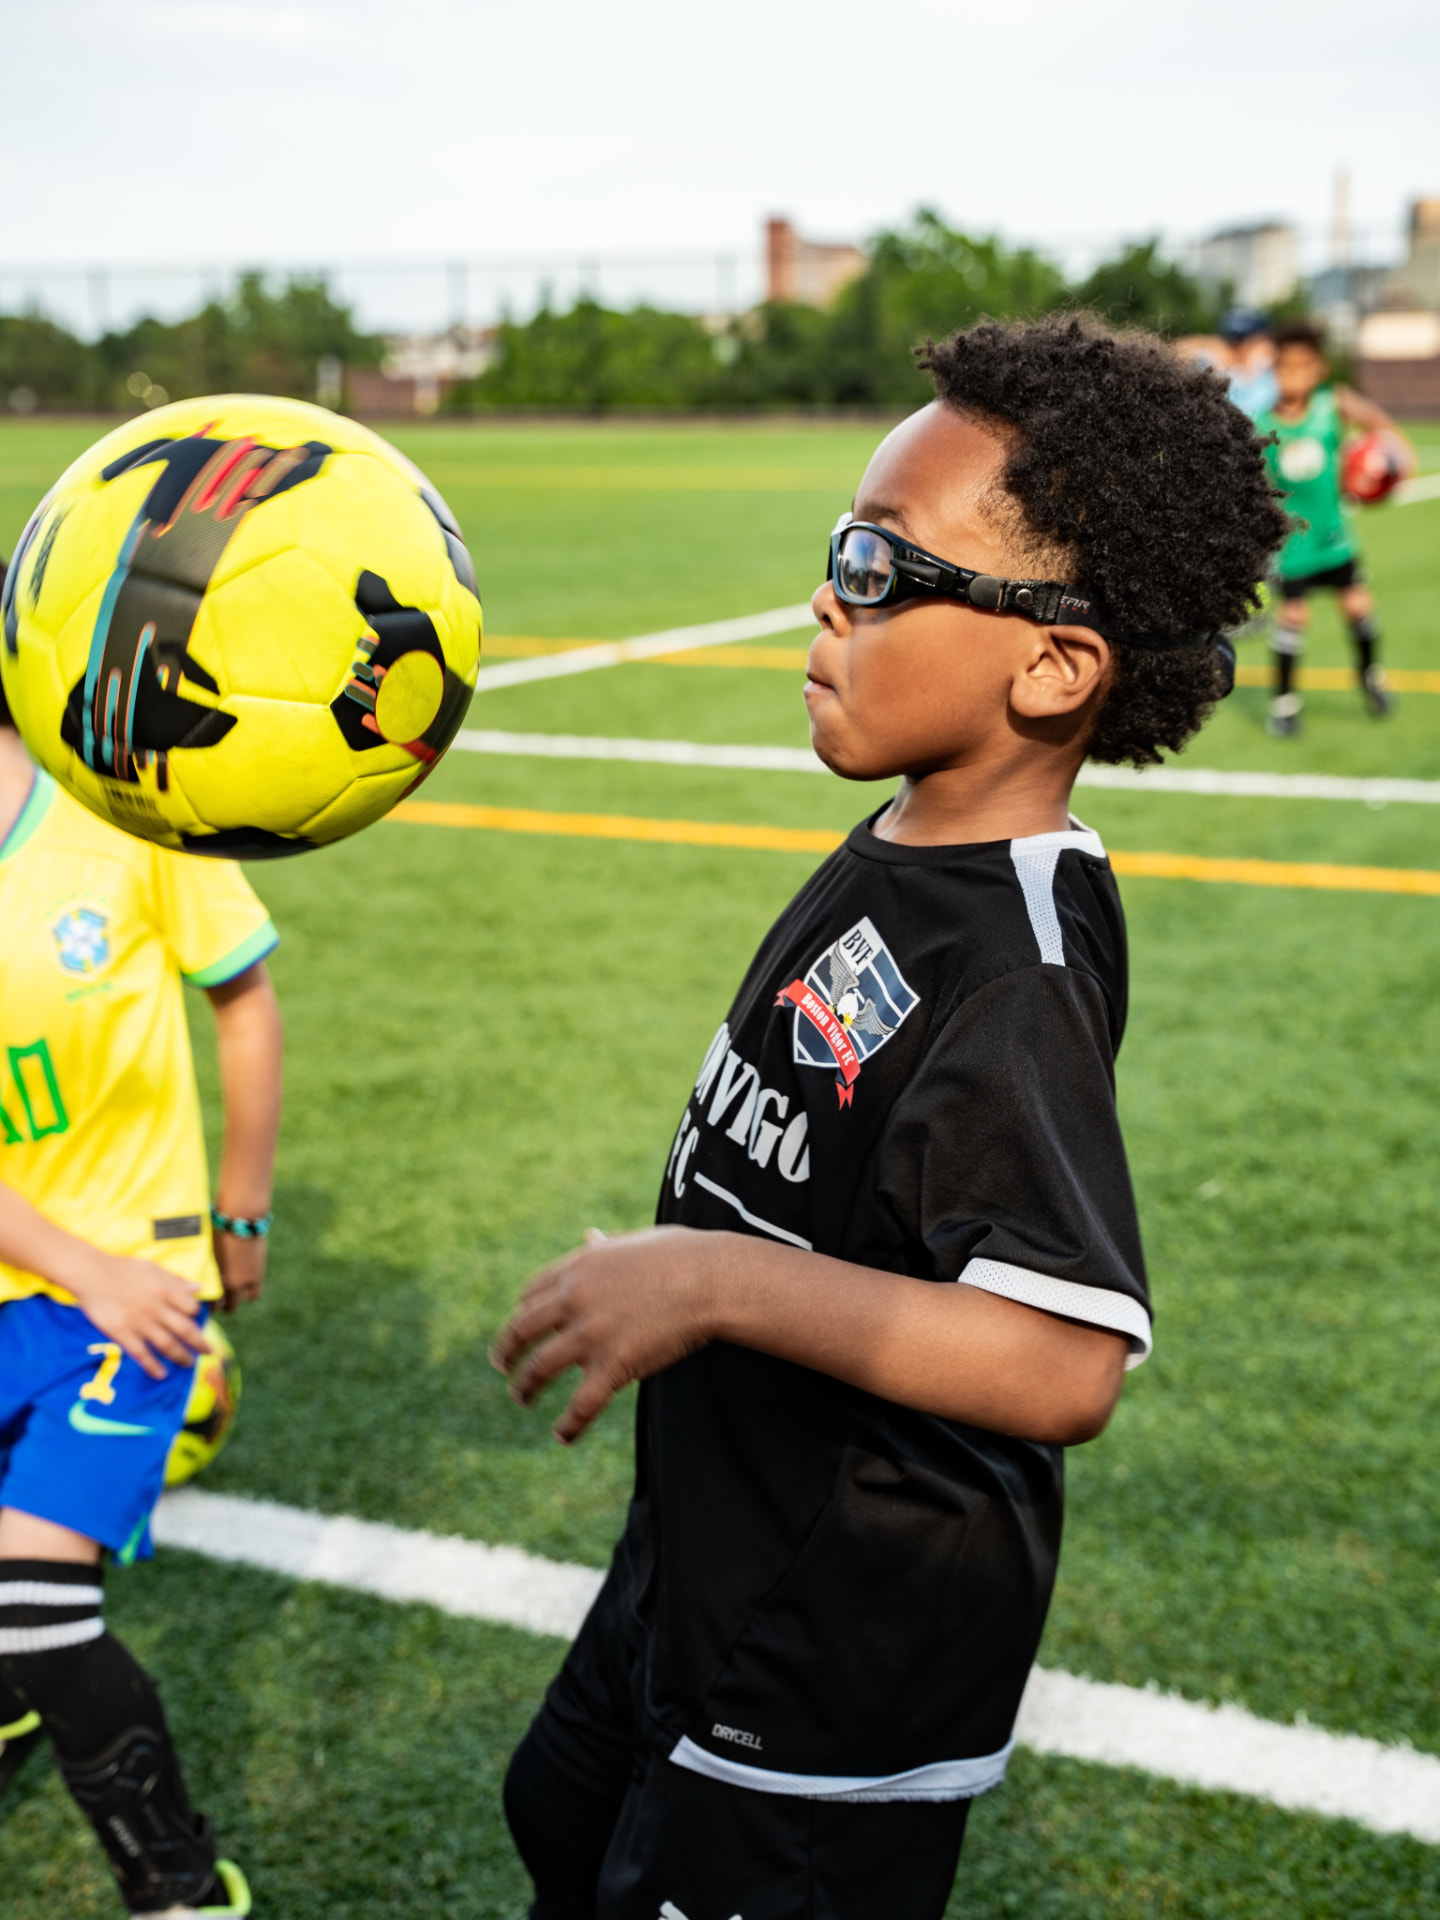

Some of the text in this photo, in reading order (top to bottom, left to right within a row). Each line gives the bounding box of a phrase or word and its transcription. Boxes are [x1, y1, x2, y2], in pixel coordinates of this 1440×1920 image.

[842, 928, 874, 966] BVF
[841, 1049, 855, 1066] FC
[711, 1722, 763, 1751] DRYCELL
